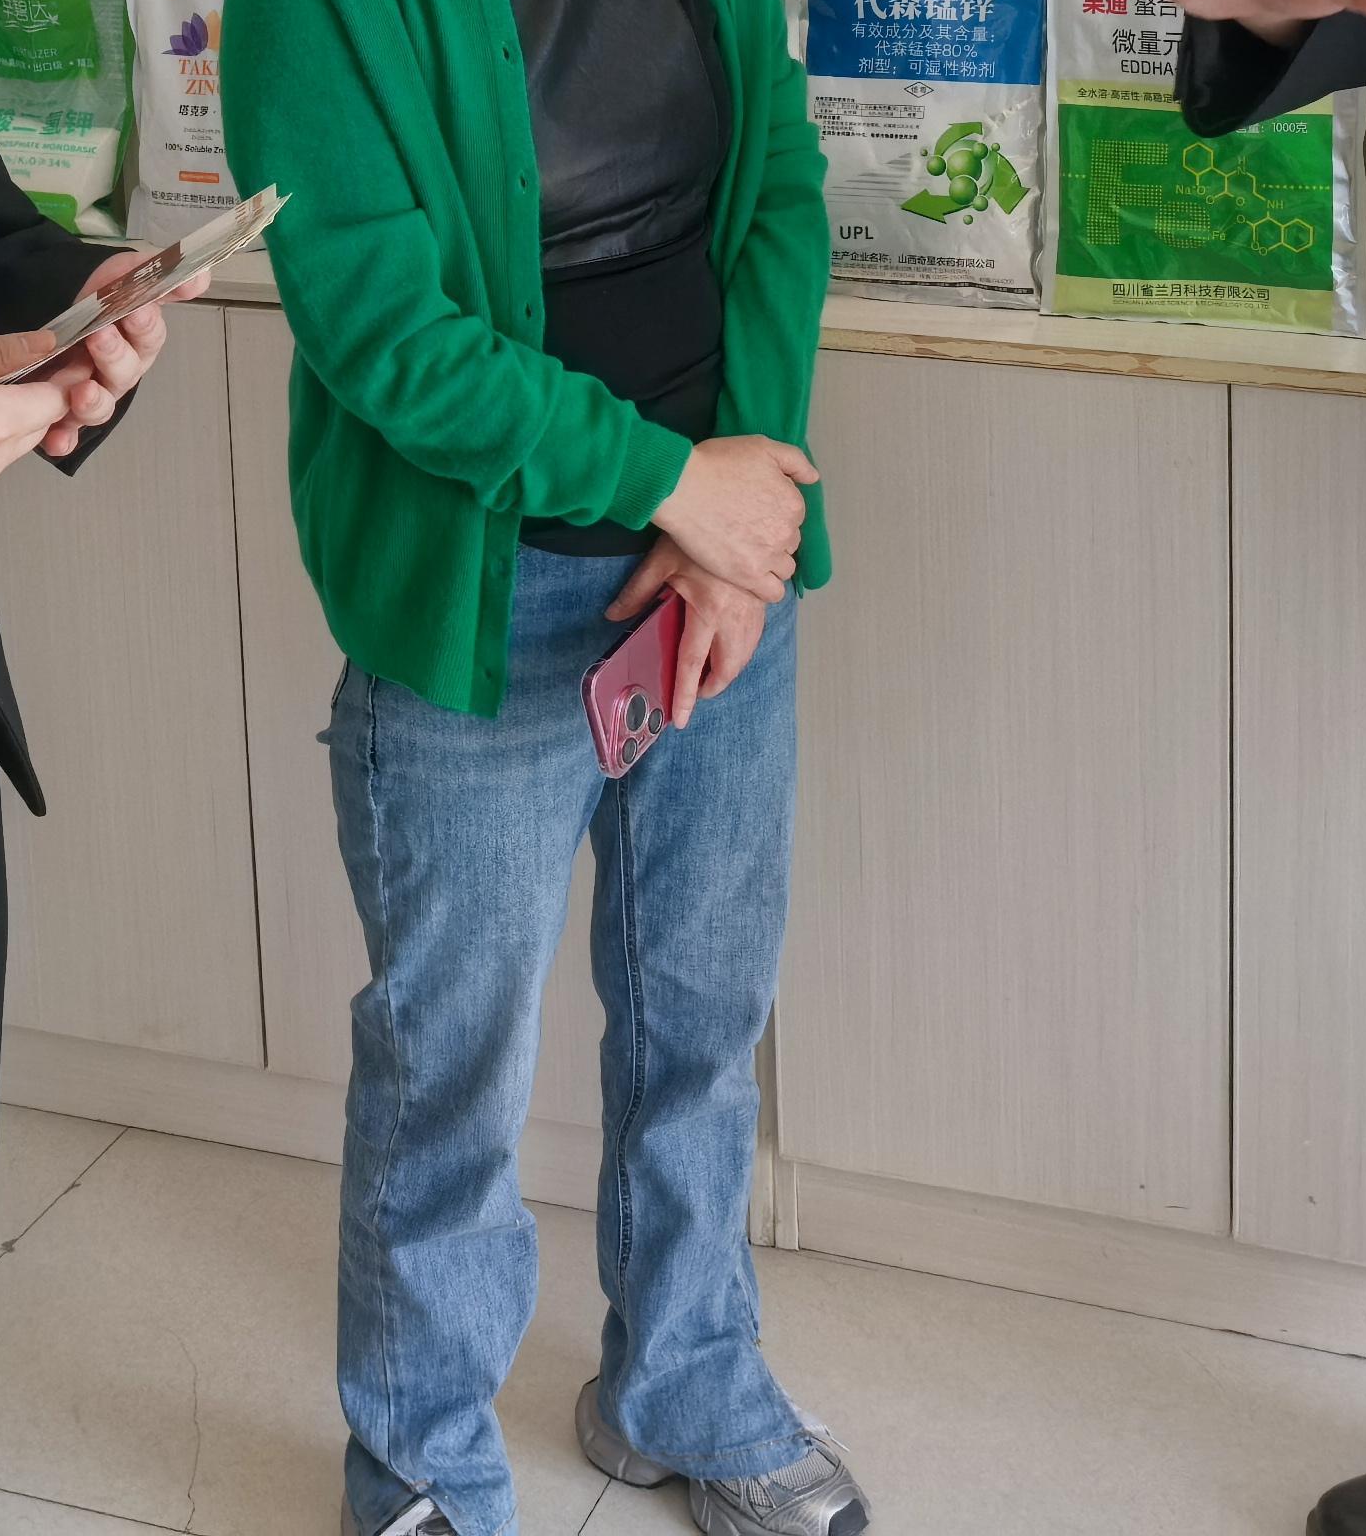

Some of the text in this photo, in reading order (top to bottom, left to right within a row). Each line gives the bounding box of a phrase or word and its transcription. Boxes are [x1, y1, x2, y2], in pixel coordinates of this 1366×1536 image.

[875, 41, 978, 58] 代森锰锌80%
[185, 79, 220, 96] ZIN
[1272, 122, 1308, 134] 1000克
[839, 226, 874, 240] UPL
[1112, 283, 1270, 301] 四川省兰月科技有限公司
